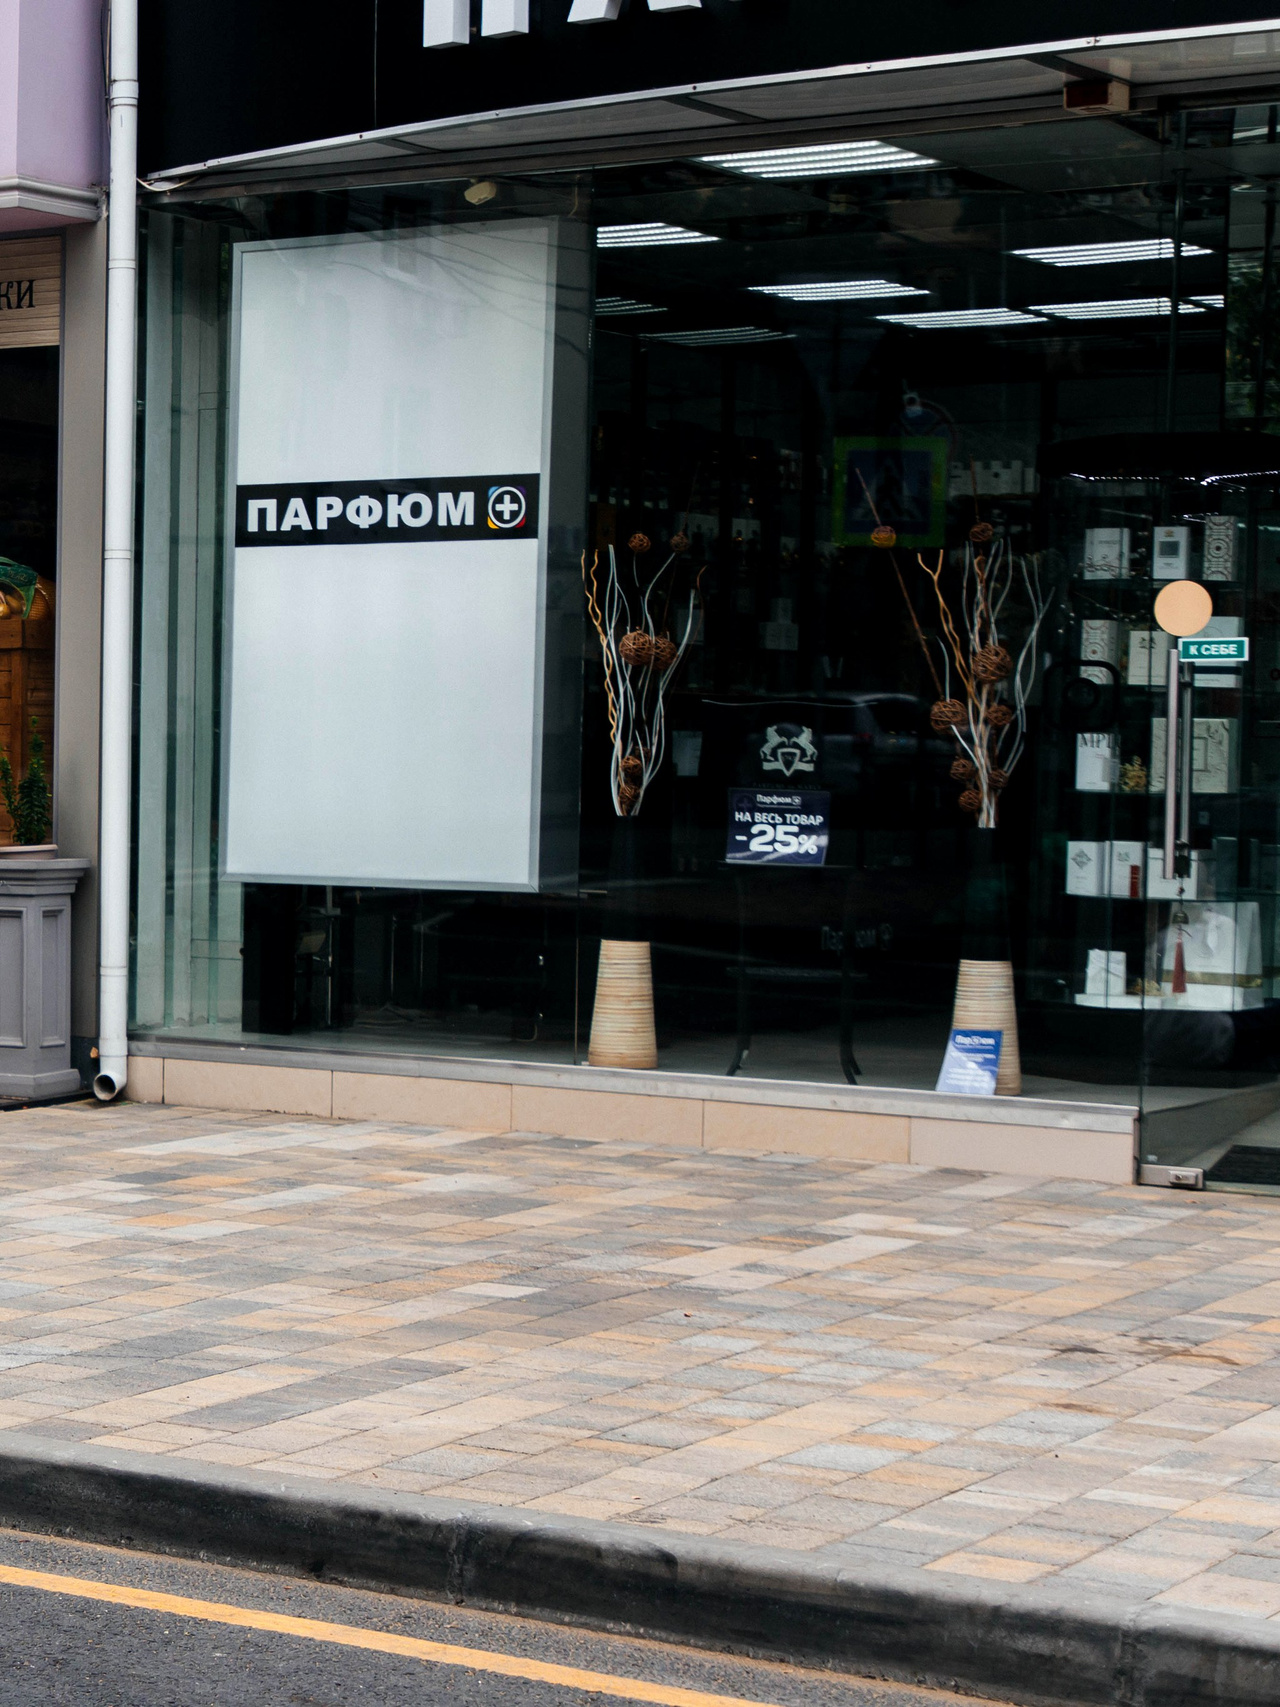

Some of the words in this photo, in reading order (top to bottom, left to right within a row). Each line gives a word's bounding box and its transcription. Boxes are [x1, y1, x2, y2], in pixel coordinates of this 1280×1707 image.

[247, 491, 475, 532] ПАРФЮМ
[1189, 645, 1198, 655] К
[1201, 644, 1238, 655] СЕБЕ
[735, 811, 752, 823] НА
[754, 812, 783, 823] ВЕСЬ
[784, 813, 824, 826] ТОВАР
